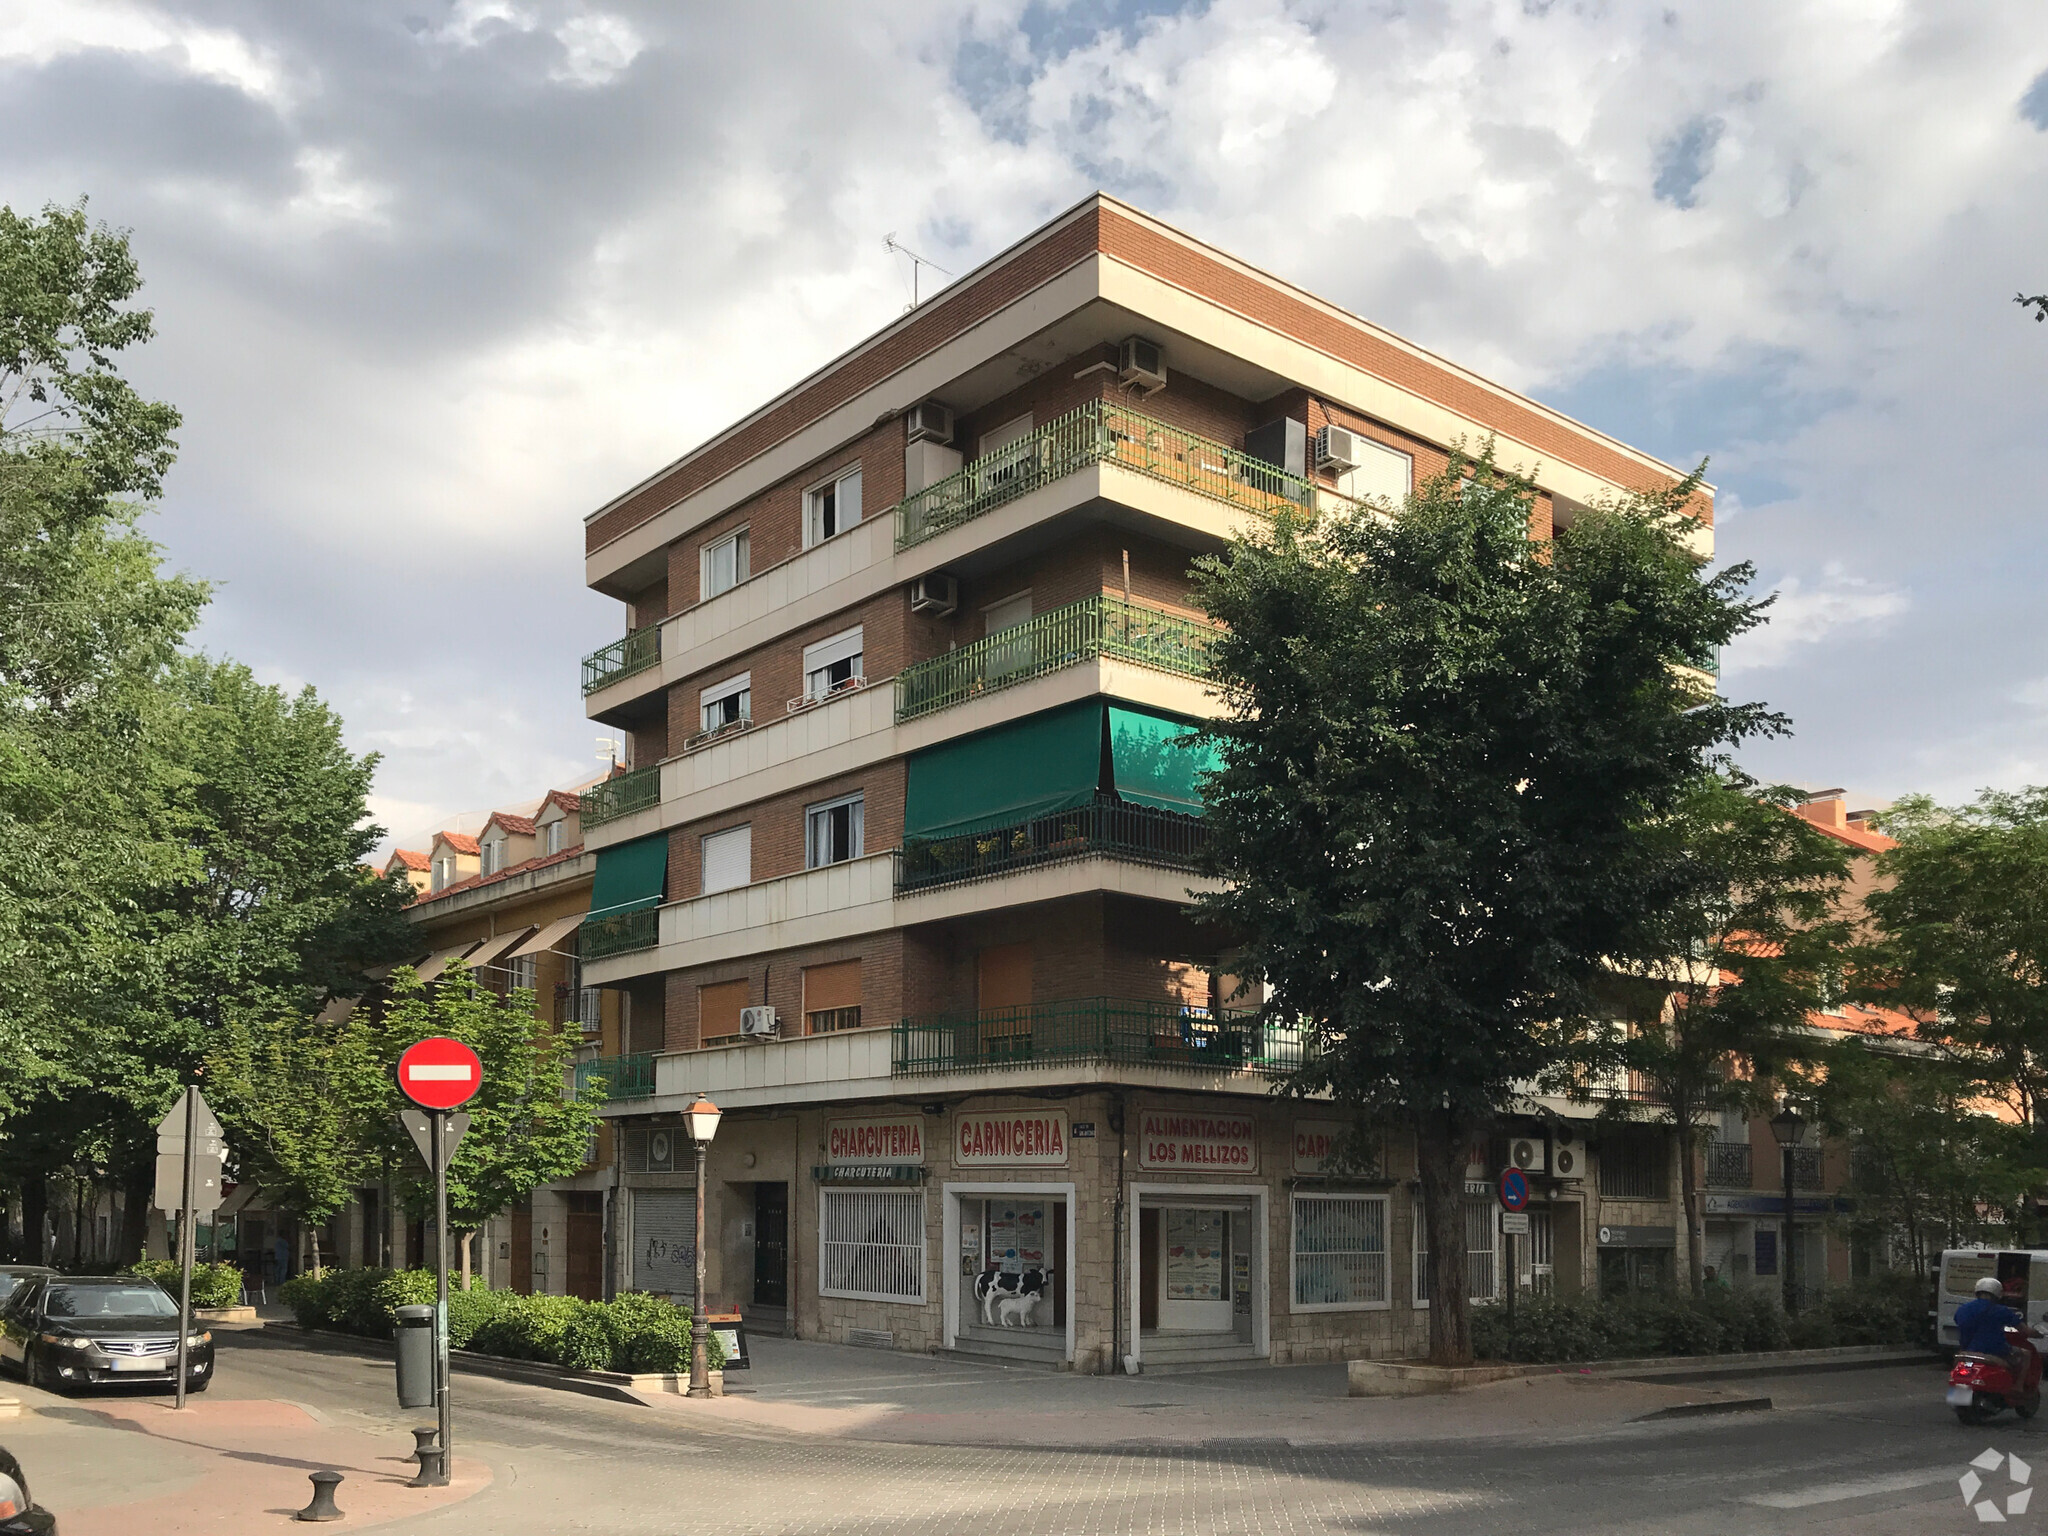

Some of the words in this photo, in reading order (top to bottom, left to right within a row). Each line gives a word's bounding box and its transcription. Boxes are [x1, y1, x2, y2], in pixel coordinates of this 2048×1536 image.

[960, 1119, 1063, 1157] CARNICERIA
[1144, 1116, 1252, 1140] ALIMENTACION
[831, 1124, 921, 1158] CHARCUTERIA
[1148, 1142, 1176, 1162] LOS
[1181, 1143, 1249, 1165] MELLIZOS
[834, 1167, 892, 1178] CHARCUTERIA
